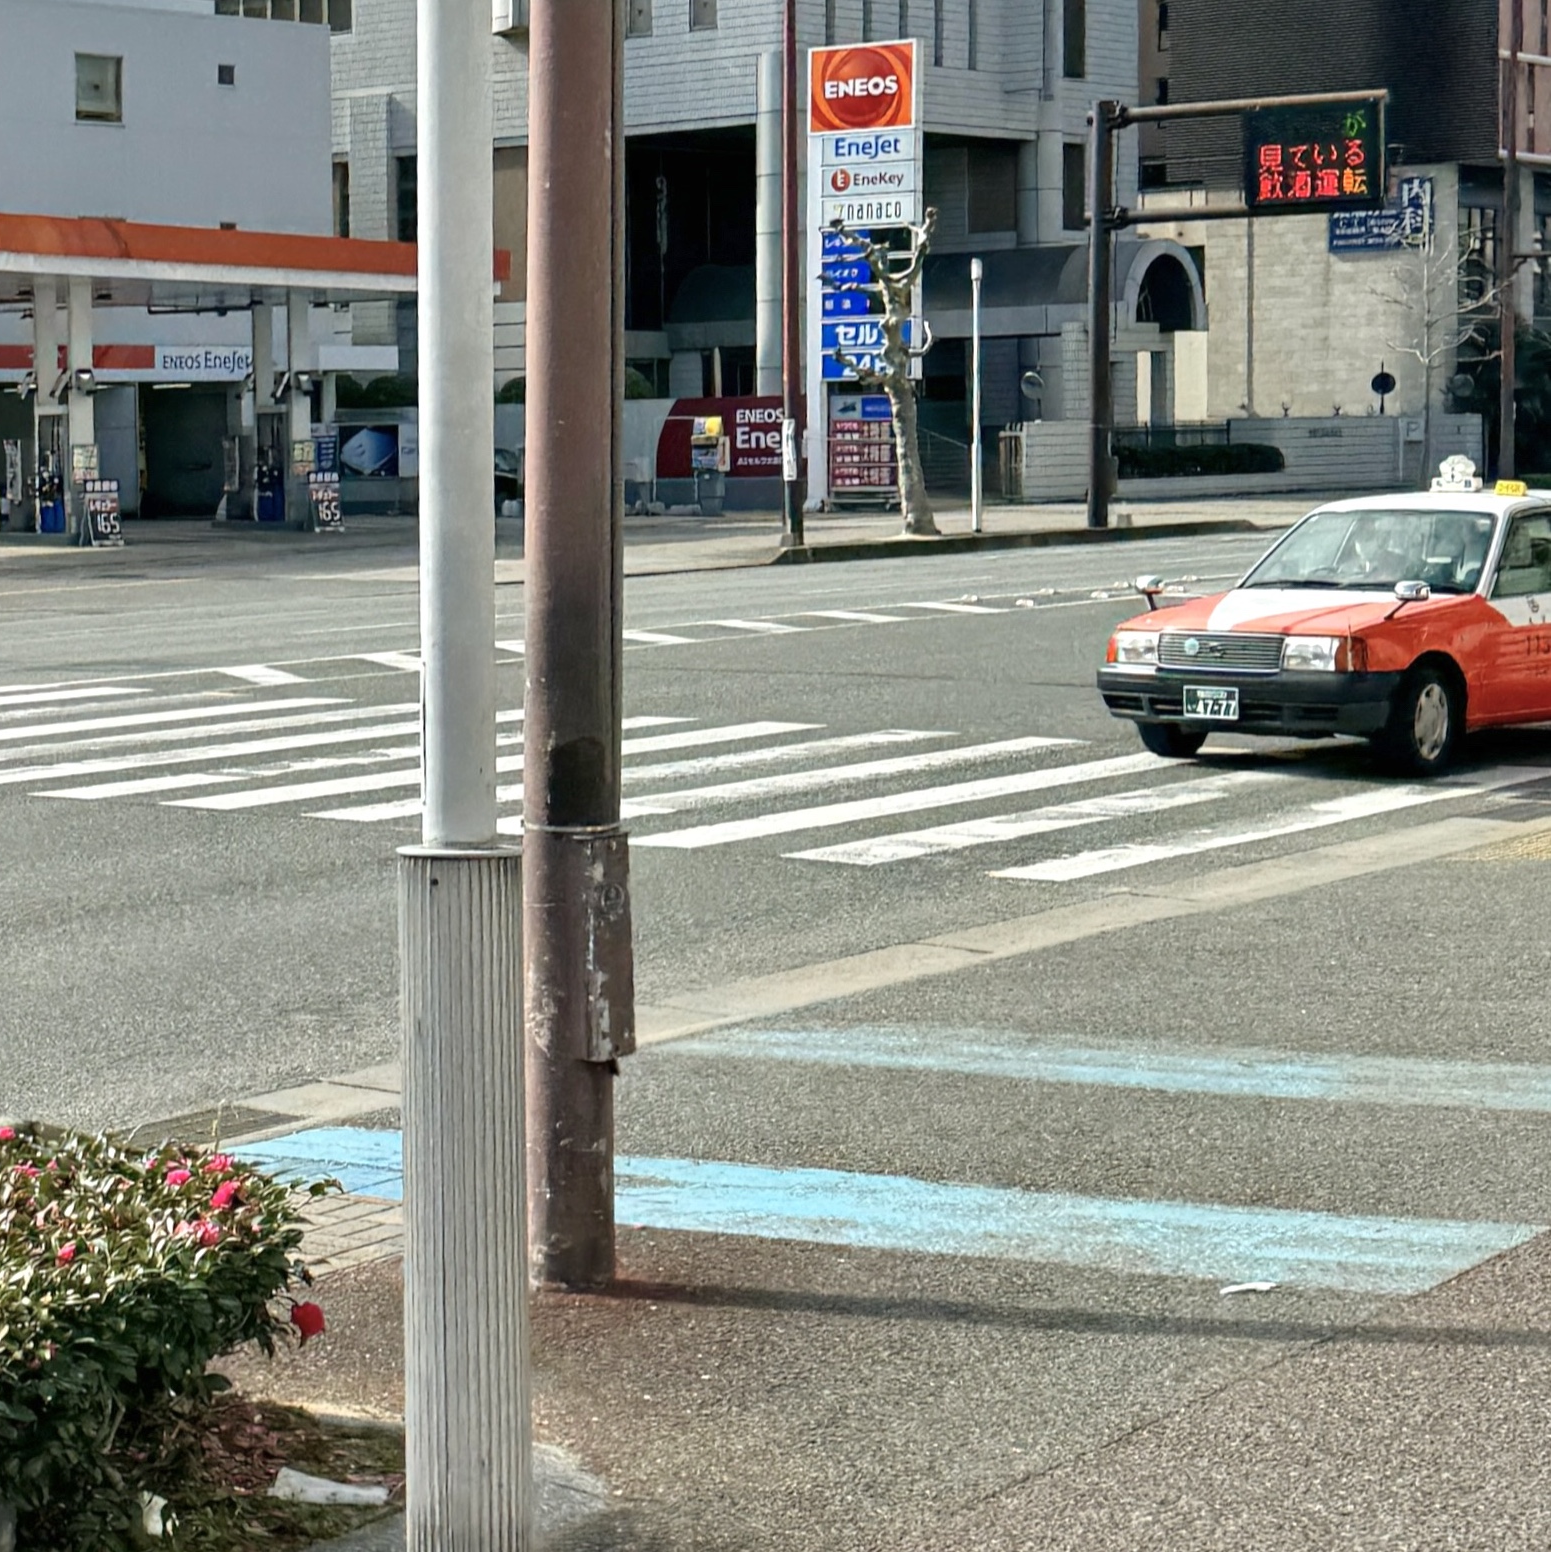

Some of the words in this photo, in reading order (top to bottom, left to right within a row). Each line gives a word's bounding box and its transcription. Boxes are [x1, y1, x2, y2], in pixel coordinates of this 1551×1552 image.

[824, 75, 899, 99] ENEOS
[1346, 109, 1367, 136] が
[834, 135, 901, 159] EneJet
[1259, 139, 1365, 171] 見ている
[853, 172, 904, 187] EneKey
[1258, 166, 1367, 200] 飲酒運転
[847, 201, 902, 221] nanaco
[836, 324, 888, 346] セル
[163, 353, 201, 369] ENEOS
[736, 408, 784, 423] ENEOS
[1406, 421, 1419, 436] P
[97, 513, 120, 534] 165
